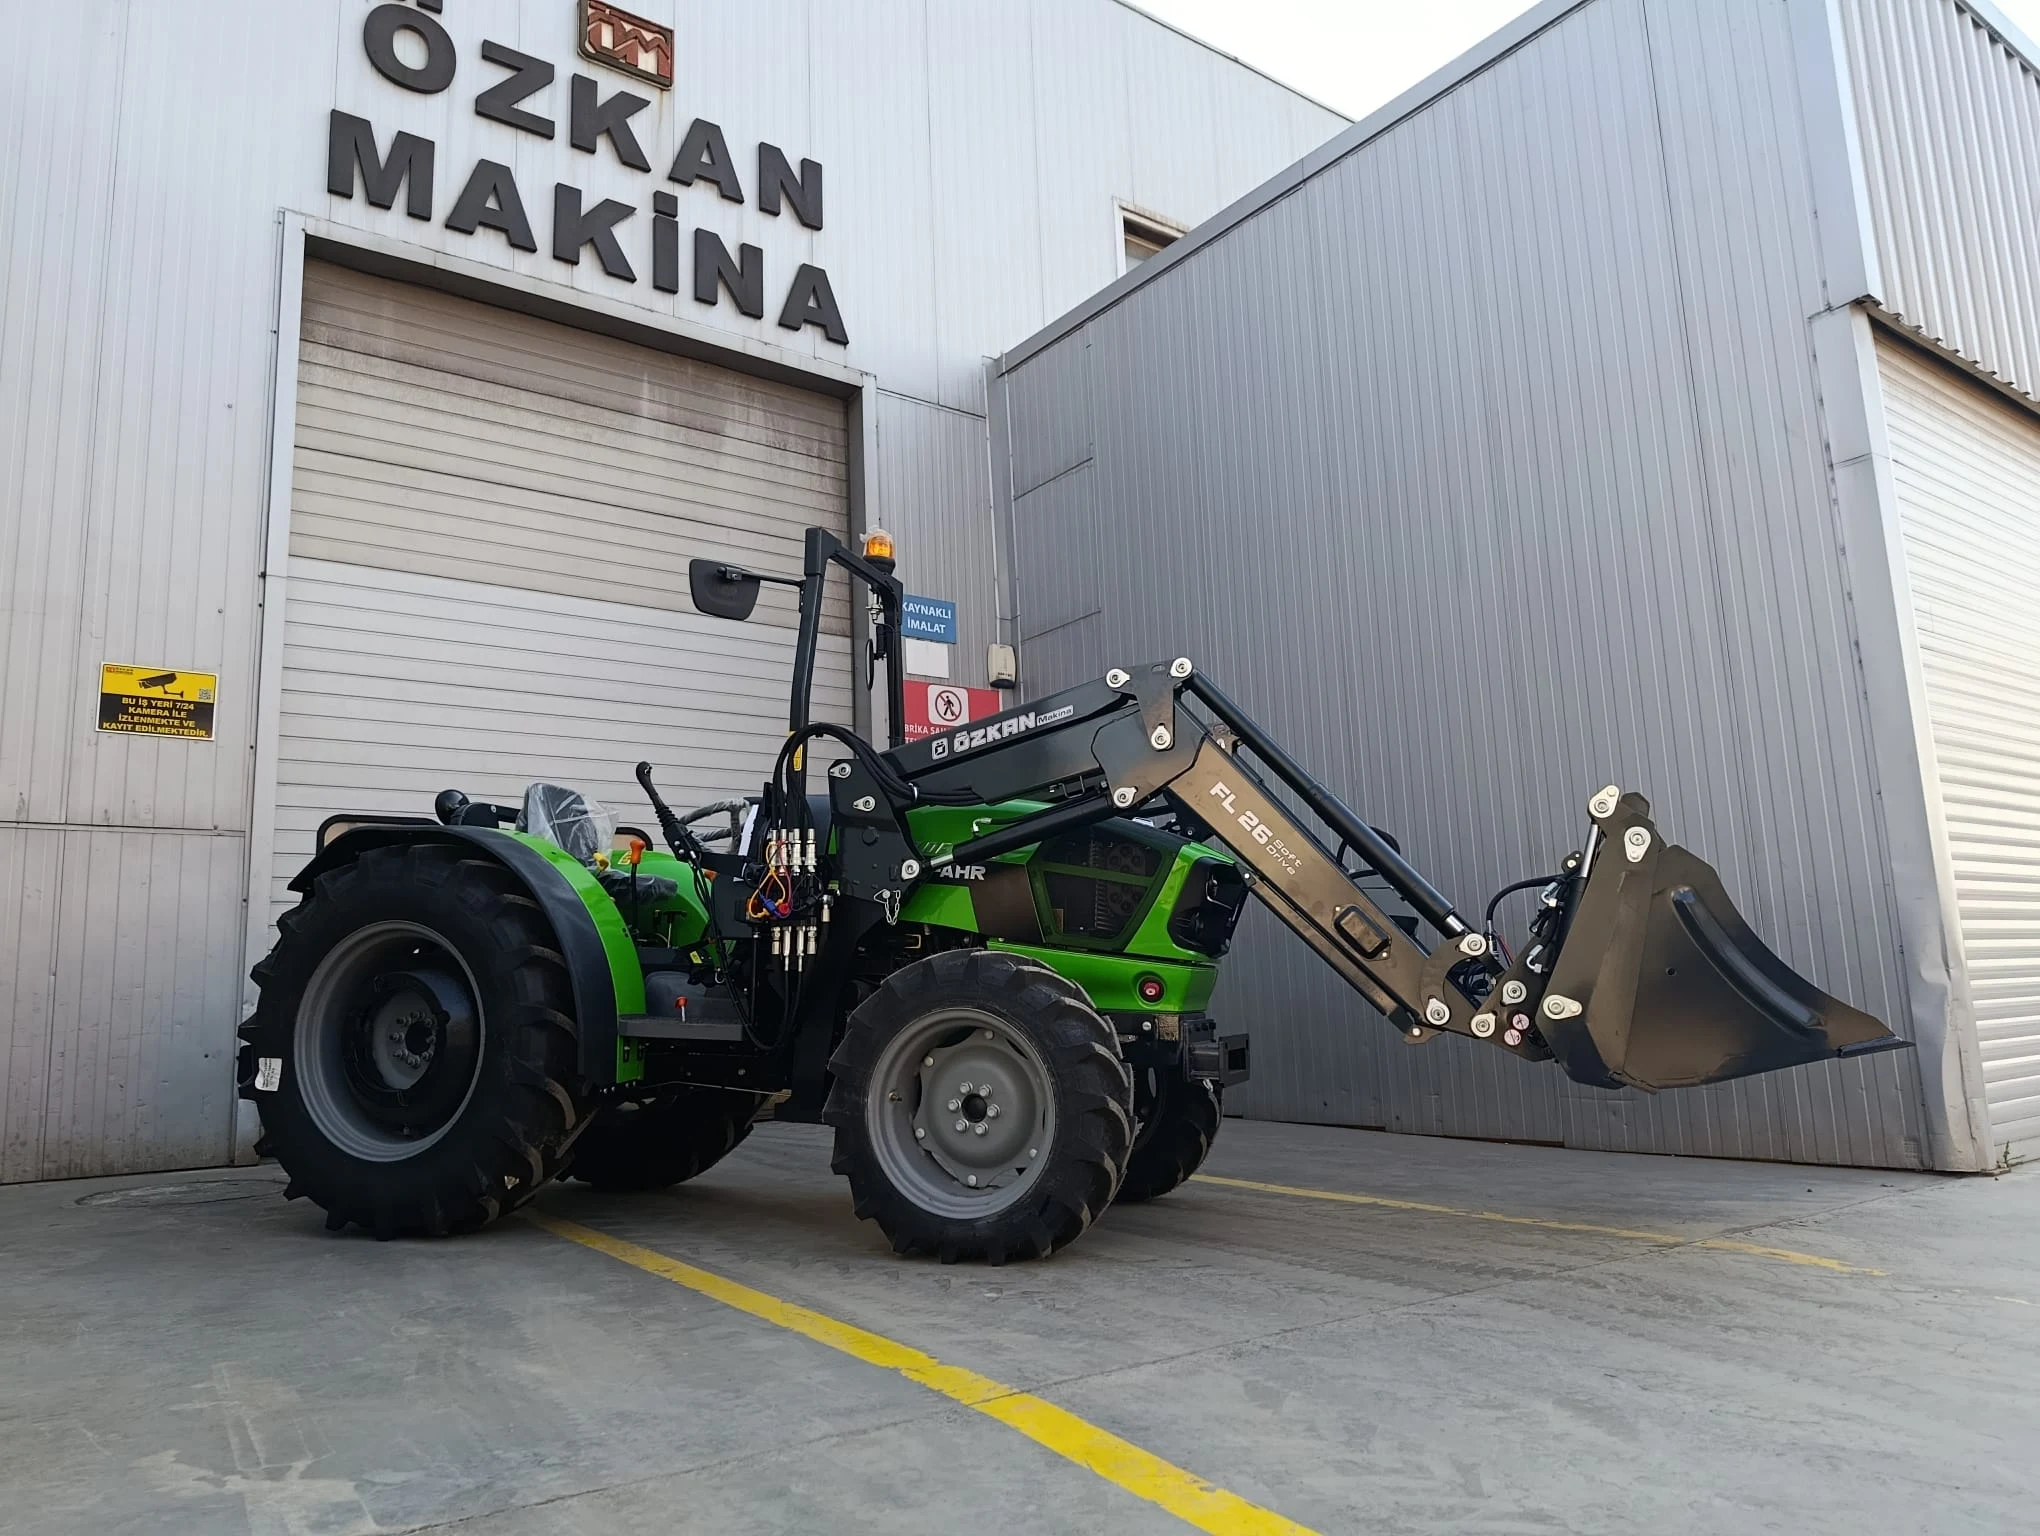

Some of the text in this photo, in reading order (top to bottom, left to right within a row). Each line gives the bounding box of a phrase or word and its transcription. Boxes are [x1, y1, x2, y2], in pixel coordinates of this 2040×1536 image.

[363, 0, 823, 231] ÖZKAN
[328, 109, 849, 346] MAKİNA
[903, 601, 952, 620] KAYNAKLI
[907, 616, 946, 634] İMALAT
[121, 697, 194, 710] BU İŞ YERİ 7/24
[128, 706, 187, 718] KAMERA İLE
[102, 722, 209, 737] KAYIT EDİLMEKTEDİR.
[118, 713, 196, 728] İZLENMEKTE VE
[953, 711, 1036, 752] ÖZKAN
[1038, 708, 1073, 725] Makina
[1209, 781, 1274, 845] FL 26
[1265, 844, 1296, 876] Drive
[1273, 839, 1302, 868] Soft
[937, 864, 986, 881] AHR
